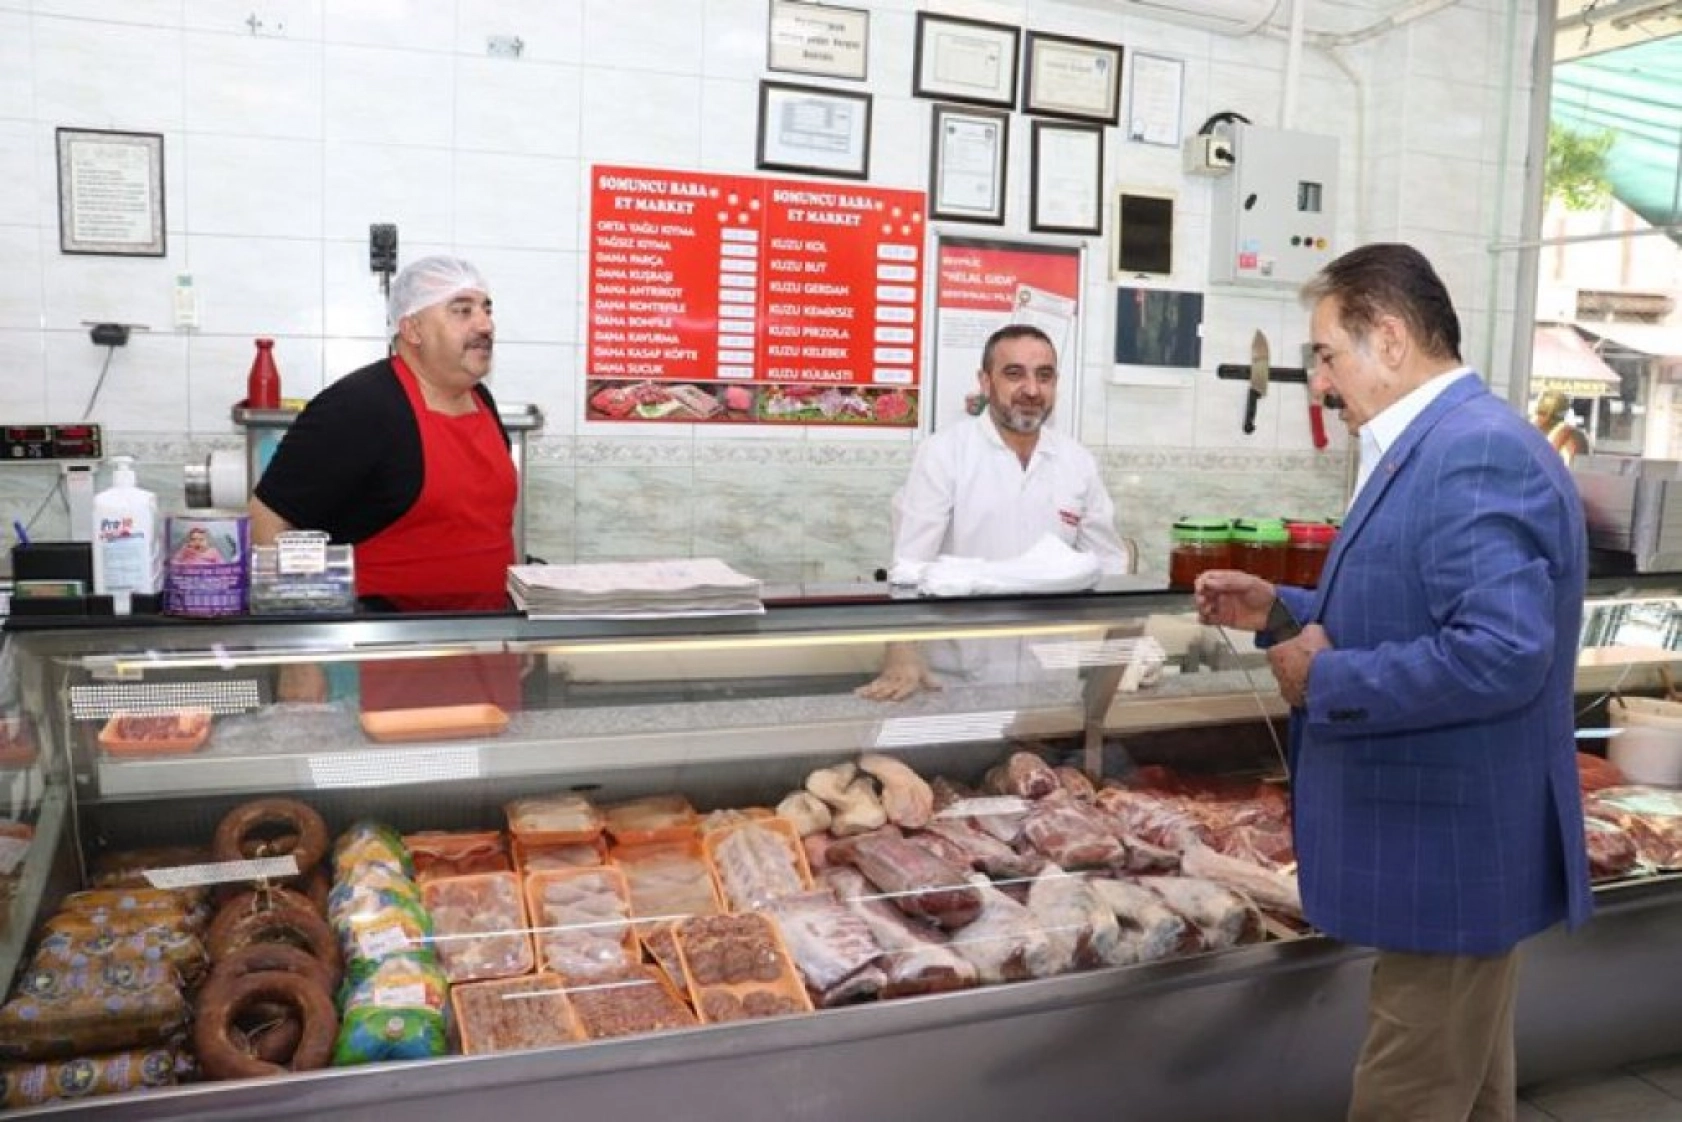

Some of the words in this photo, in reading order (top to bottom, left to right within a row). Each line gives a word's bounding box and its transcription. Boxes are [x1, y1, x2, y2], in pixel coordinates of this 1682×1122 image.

[670, 182, 708, 198] BABA
[614, 197, 633, 209] ET
[635, 199, 695, 214] MARKET
[839, 195, 873, 210] BABA
[787, 209, 805, 222] ET
[806, 211, 862, 226] MARKET
